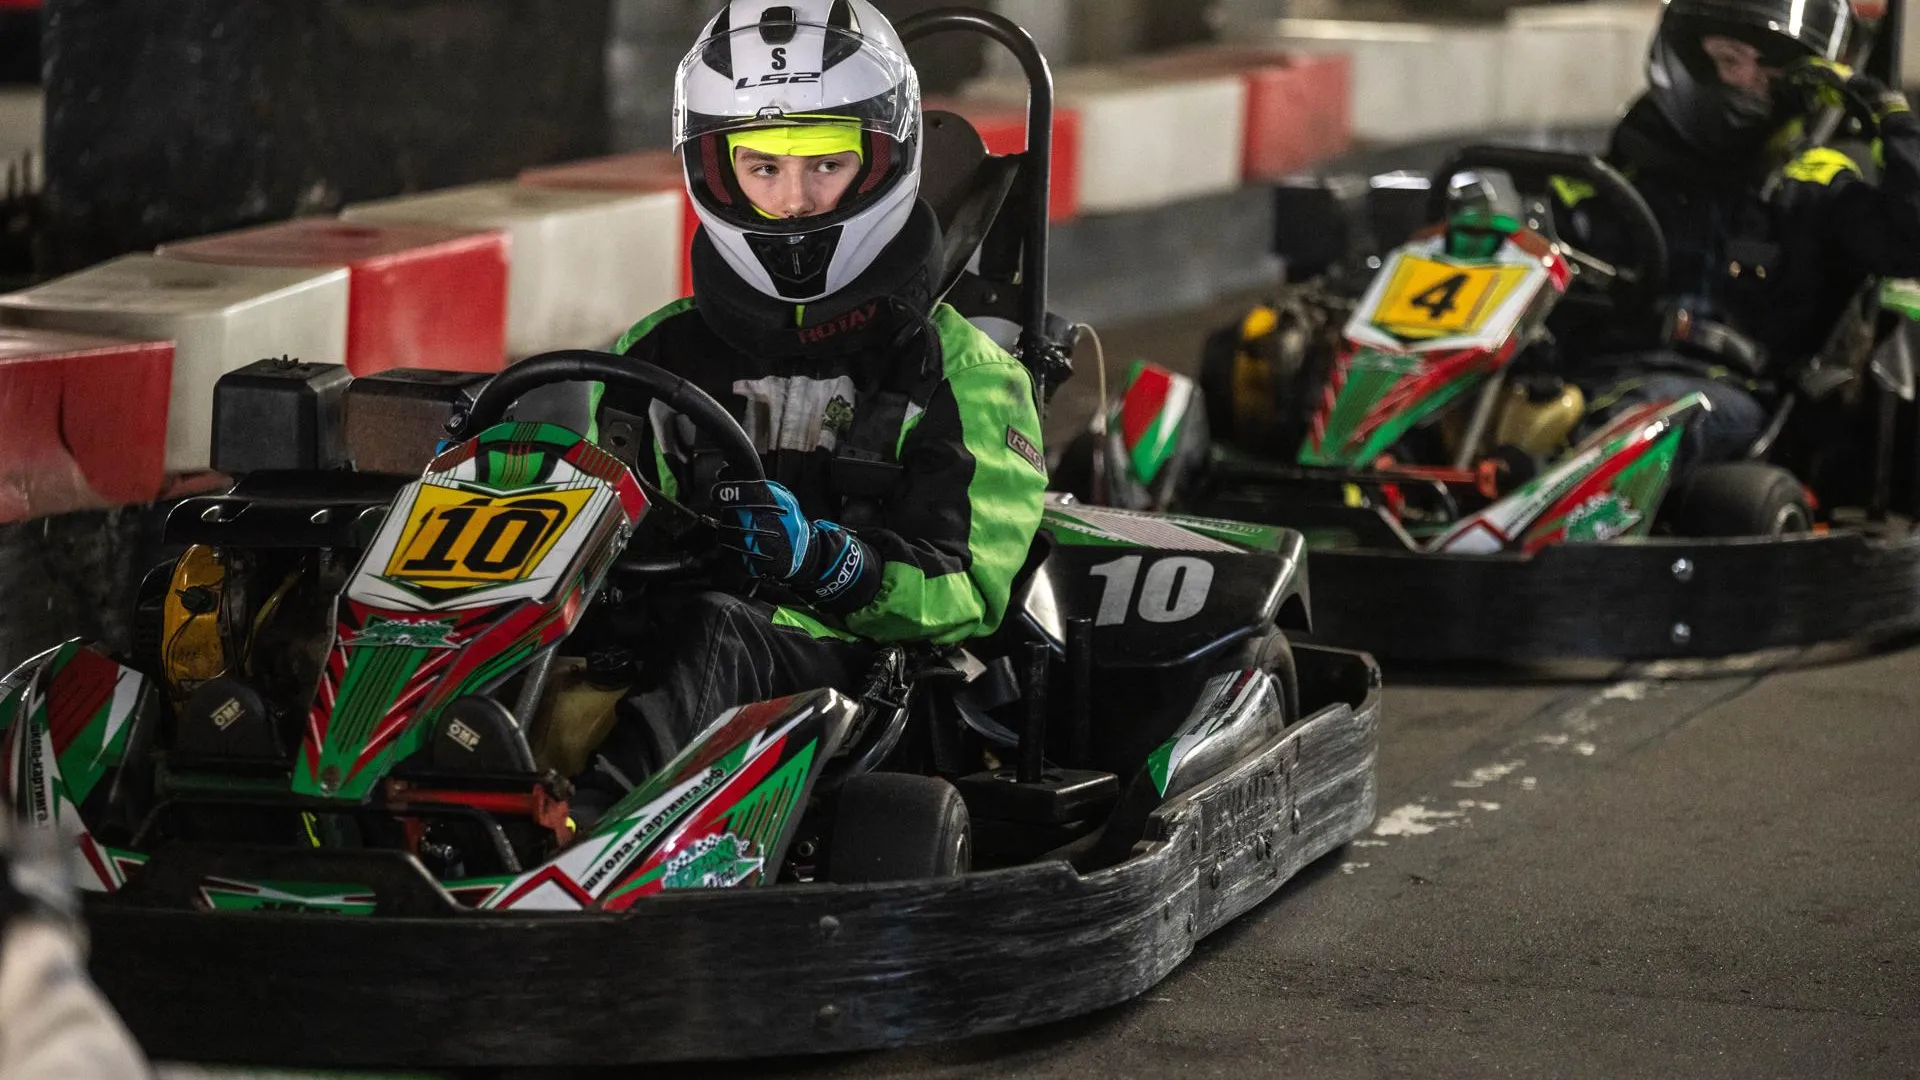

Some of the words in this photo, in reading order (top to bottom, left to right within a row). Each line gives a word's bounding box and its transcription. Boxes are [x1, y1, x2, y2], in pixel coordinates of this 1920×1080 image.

[735, 72, 821, 90] LS2
[771, 48, 786, 70] S
[1409, 272, 1469, 320] 4
[401, 506, 551, 574] 10
[815, 543, 862, 598] sparco
[1089, 554, 1215, 627] 10
[212, 700, 242, 728] OMP
[447, 721, 480, 748] OMP
[582, 766, 725, 893] школа-картинга.рф
